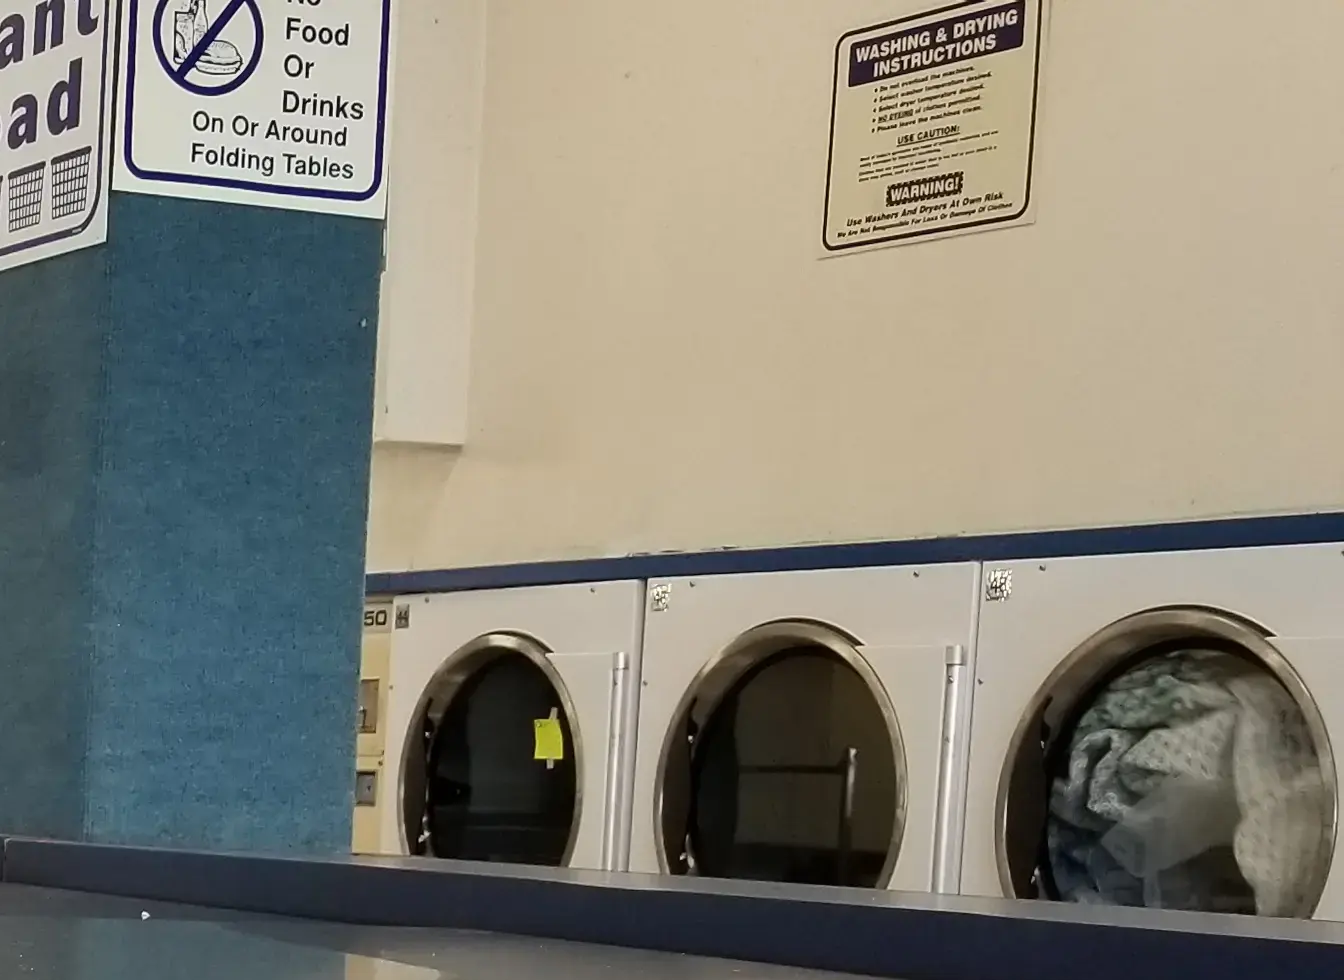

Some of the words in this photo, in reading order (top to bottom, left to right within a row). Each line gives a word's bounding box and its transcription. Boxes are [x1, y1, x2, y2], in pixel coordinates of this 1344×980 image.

[286, 17, 350, 46] Food
[855, 31, 930, 63] WASHING
[935, 27, 948, 43] &
[953, 8, 1019, 39] DRYING
[284, 54, 314, 79] Or
[873, 33, 997, 78] INSTRUCTIONS
[282, 90, 364, 120] Drinks
[193, 110, 224, 133] On
[232, 115, 259, 136] Or
[265, 120, 348, 147] Around
[897, 133, 914, 145] USE
[191, 143, 274, 177] Folding
[282, 153, 354, 179] Tables
[890, 177, 960, 202] WARNING!
[846, 218, 863, 227] Use
[864, 211, 899, 224] Washers
[900, 206, 917, 217] And
[919, 202, 947, 215] Dryers
[949, 199, 961, 208] At
[962, 195, 982, 206] Own
[984, 191, 1004, 202] Risk
